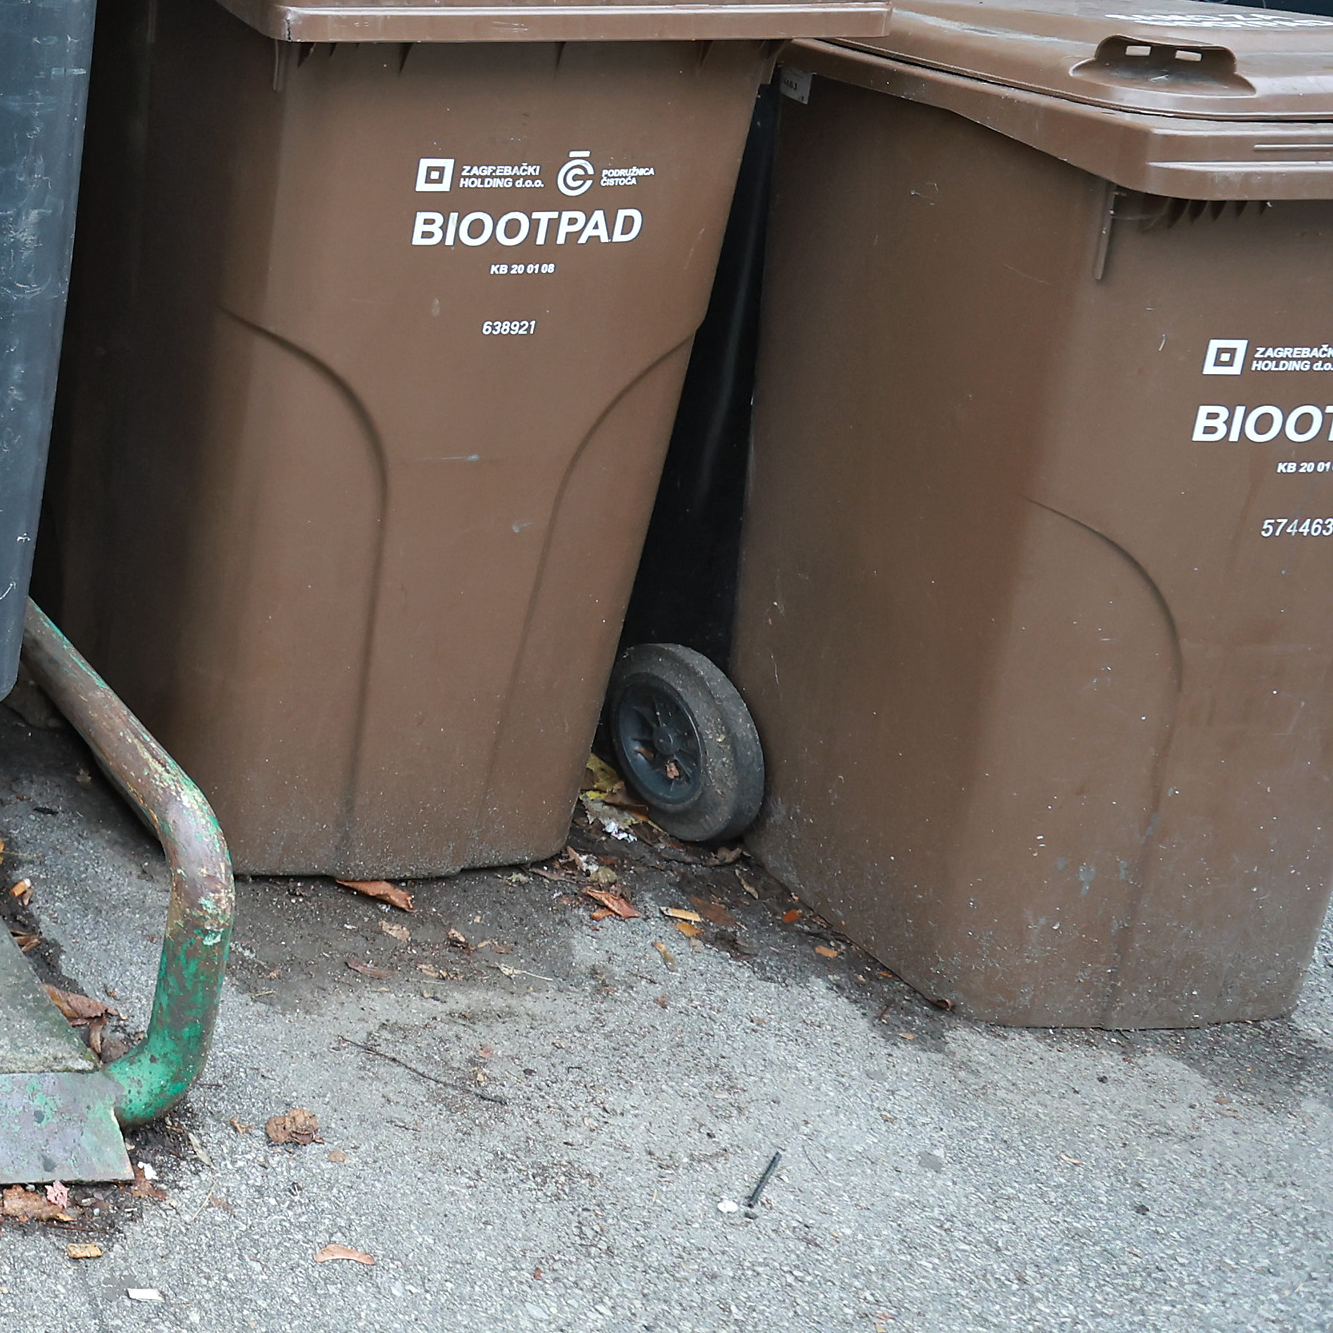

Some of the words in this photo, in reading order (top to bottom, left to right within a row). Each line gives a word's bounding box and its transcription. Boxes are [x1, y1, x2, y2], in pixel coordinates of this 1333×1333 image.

[602, 166, 655, 178] PODRUŽNICA
[459, 177, 512, 188] HOLDING
[514, 178, 544, 188] d.o.o.
[600, 175, 637, 186] ČISTOĆA
[411, 208, 643, 246] BIOOTPAD
[490, 264, 508, 275] KB
[510, 264, 525, 274] 20
[526, 263, 540, 274] 01
[540, 263, 555, 274] 08
[482, 320, 536, 335] 638921
[1254, 344, 1333, 358] ZAGREBAČK
[1251, 360, 1311, 371] HOLDING
[1313, 360, 1333, 371] d.o.
[1192, 405, 1333, 443] BIOO
[1277, 462, 1297, 473] KB
[1298, 462, 1315, 472] 20
[1317, 462, 1331, 472] 01
[1261, 518, 1333, 537] 574463
